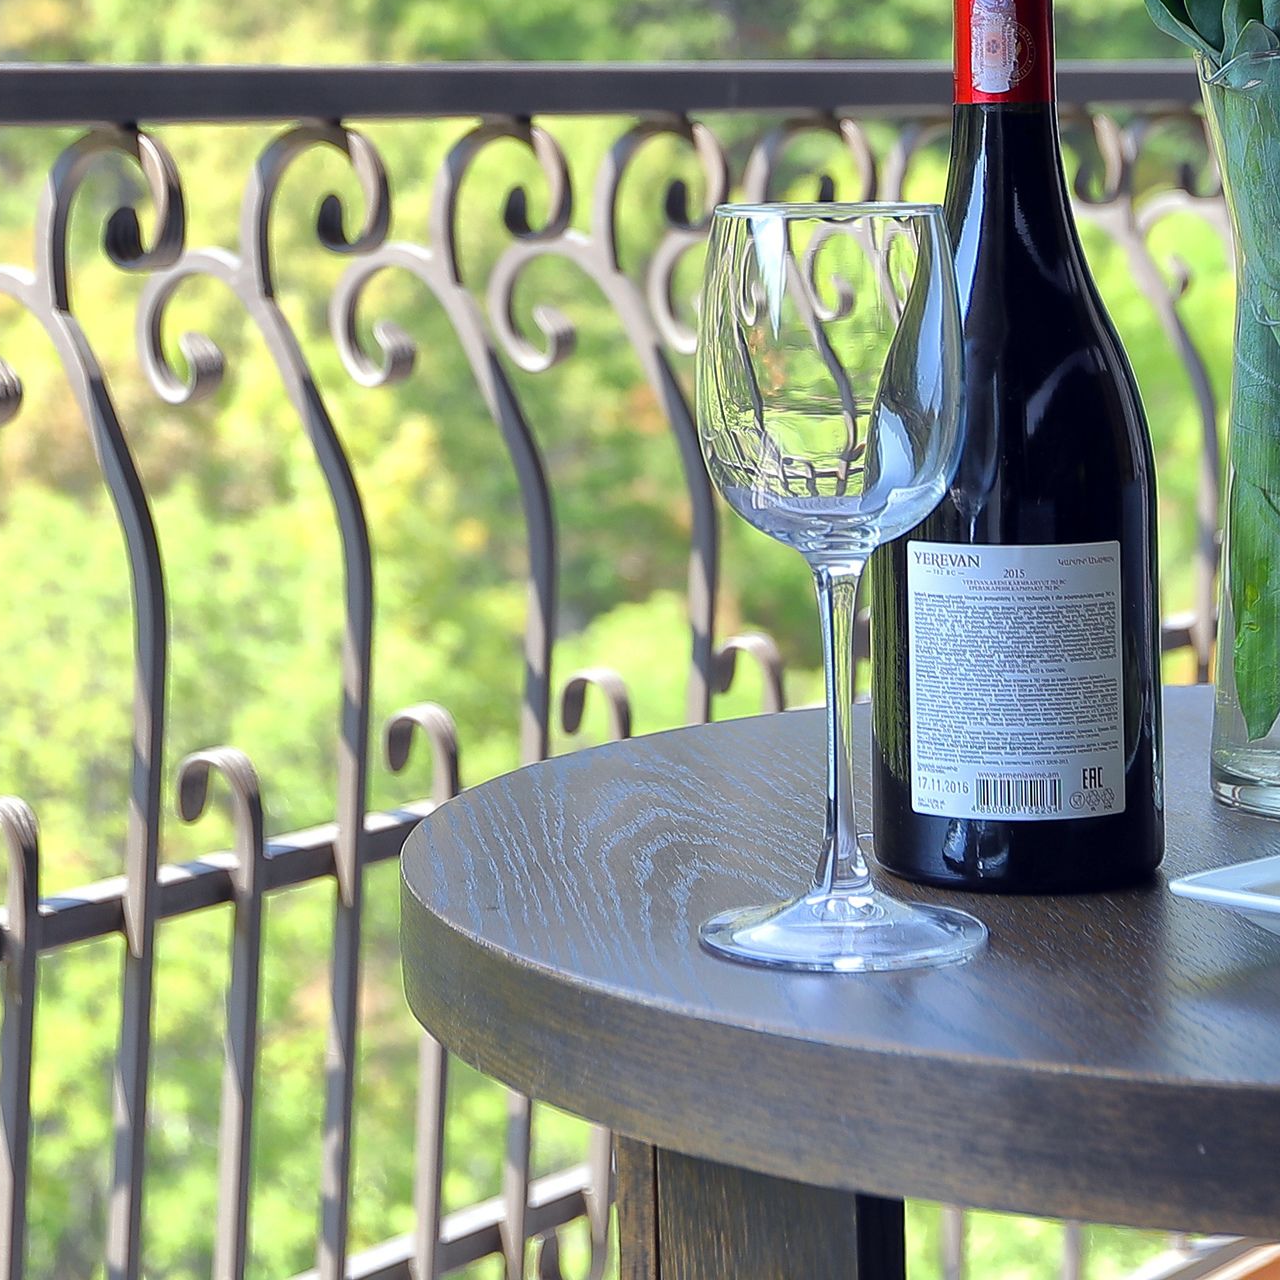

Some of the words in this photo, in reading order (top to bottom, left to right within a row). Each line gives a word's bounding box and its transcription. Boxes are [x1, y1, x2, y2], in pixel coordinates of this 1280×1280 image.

[914, 551, 980, 569] YEREVAN
[1003, 569, 1025, 578] 2015
[977, 771, 1060, 779] www.armeniawine.am
[1082, 767, 1104, 790] EAC
[918, 776, 969, 794] 17.11.2016
